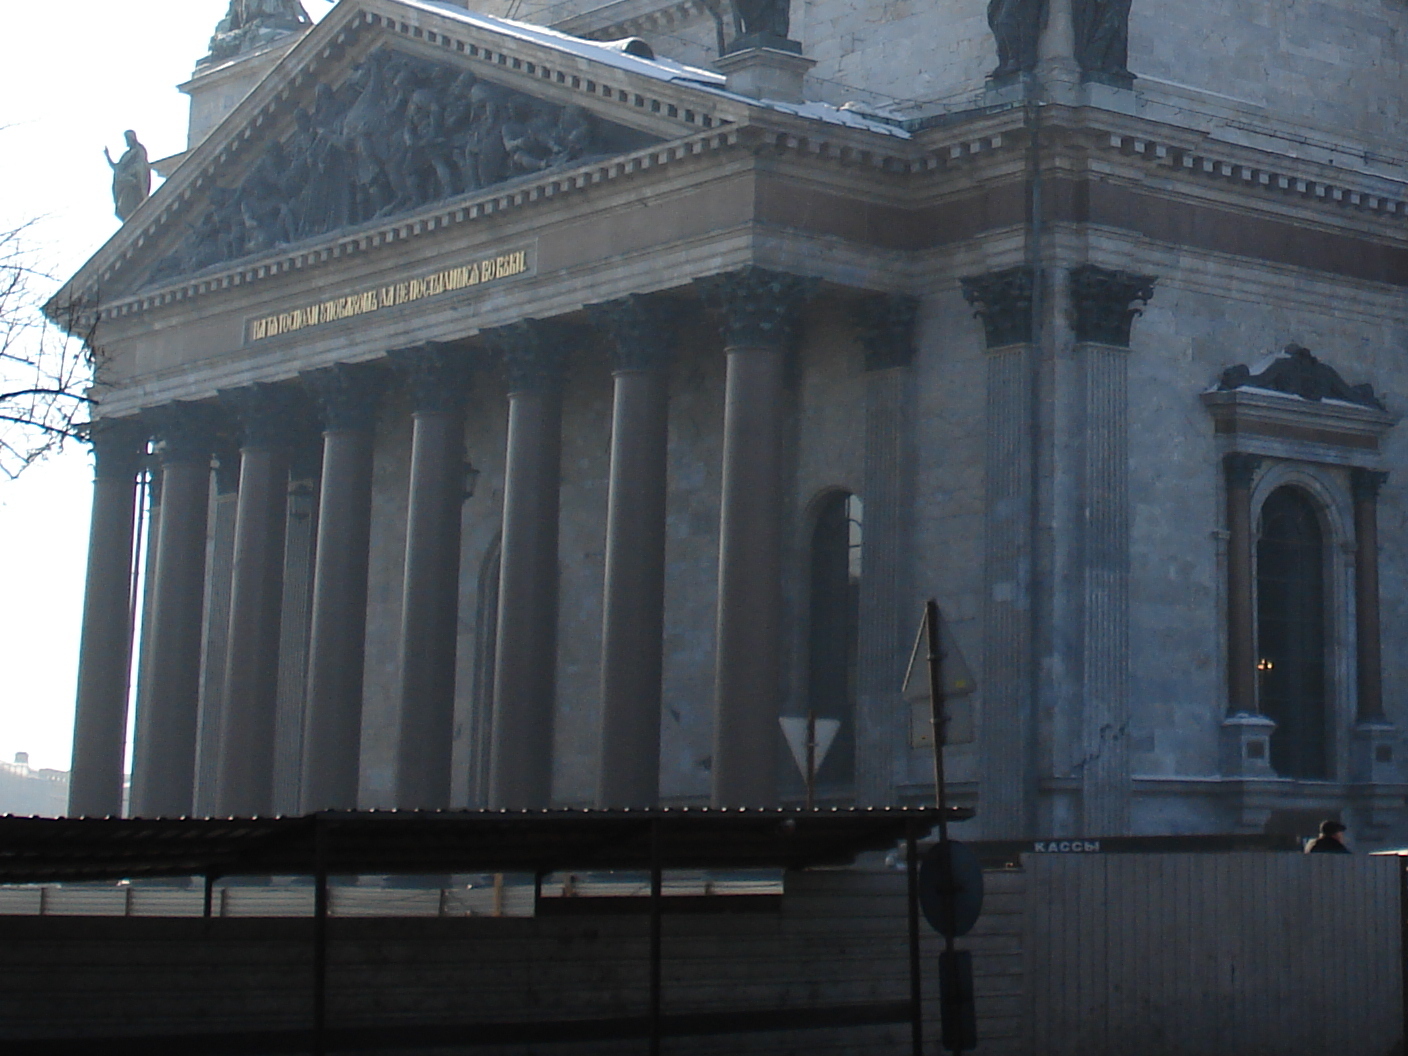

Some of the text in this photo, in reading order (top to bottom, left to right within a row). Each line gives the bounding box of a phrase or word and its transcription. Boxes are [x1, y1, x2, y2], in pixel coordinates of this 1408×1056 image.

[253, 319, 266, 340] НА
[379, 285, 395, 307] ДА
[396, 282, 408, 304] НЕ
[481, 259, 496, 283] ВО
[1034, 841, 1100, 852] КАССЫ
